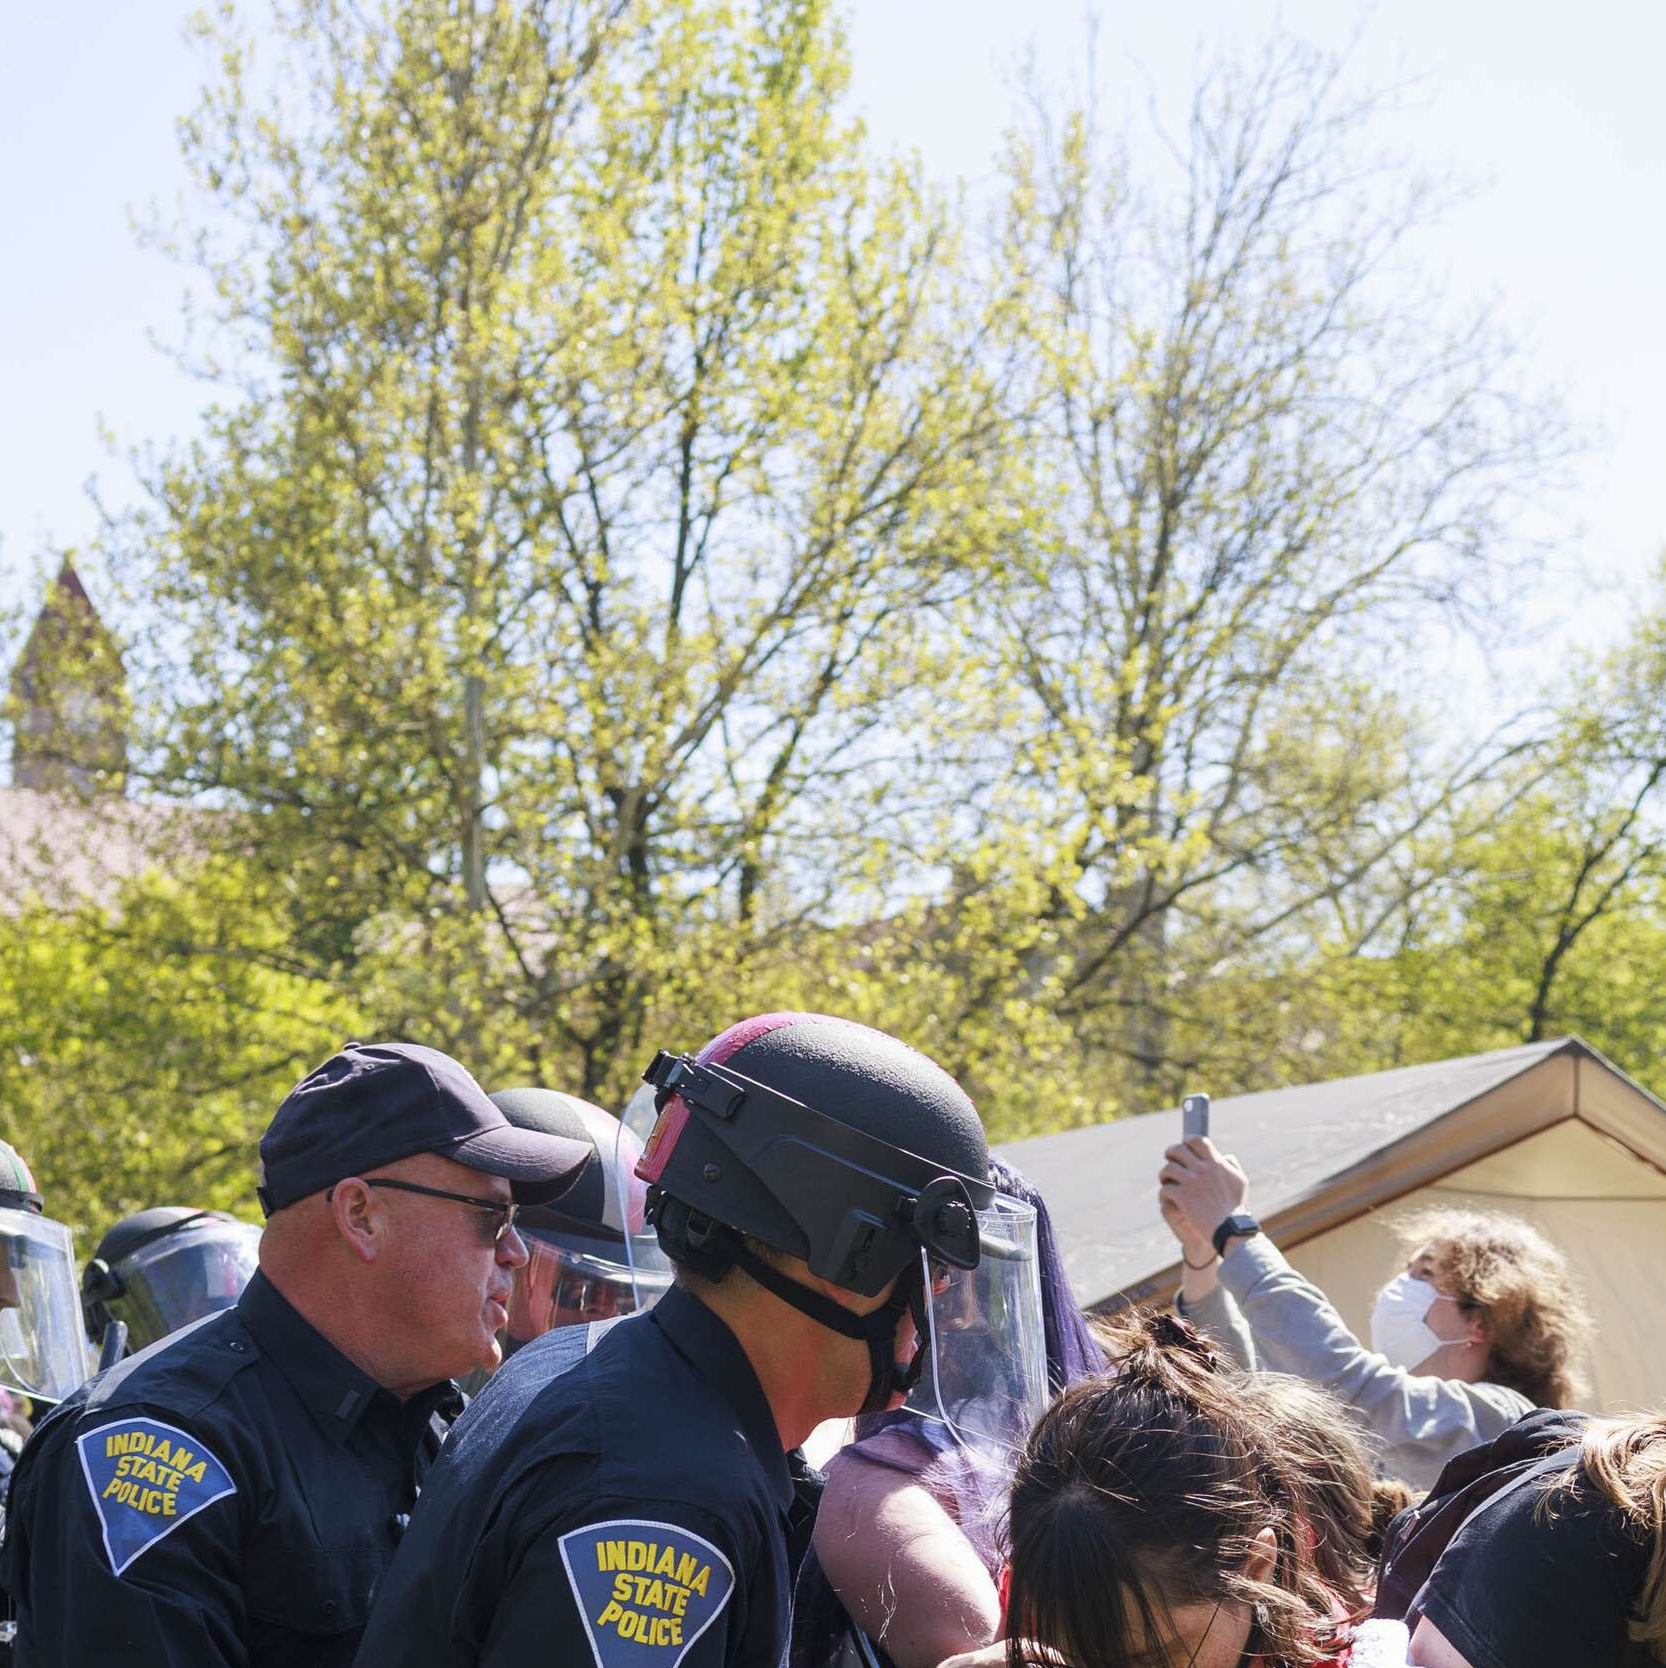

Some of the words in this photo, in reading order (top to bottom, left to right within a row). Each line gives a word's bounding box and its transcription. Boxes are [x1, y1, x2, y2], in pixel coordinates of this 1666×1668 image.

[106, 1431, 208, 1484] INDIANA
[115, 1456, 186, 1493] STATE
[102, 1477, 177, 1516] POLICE
[595, 1540, 712, 1598] INDIANA
[612, 1572, 692, 1617] STATE
[596, 1599, 684, 1647] POLICE
